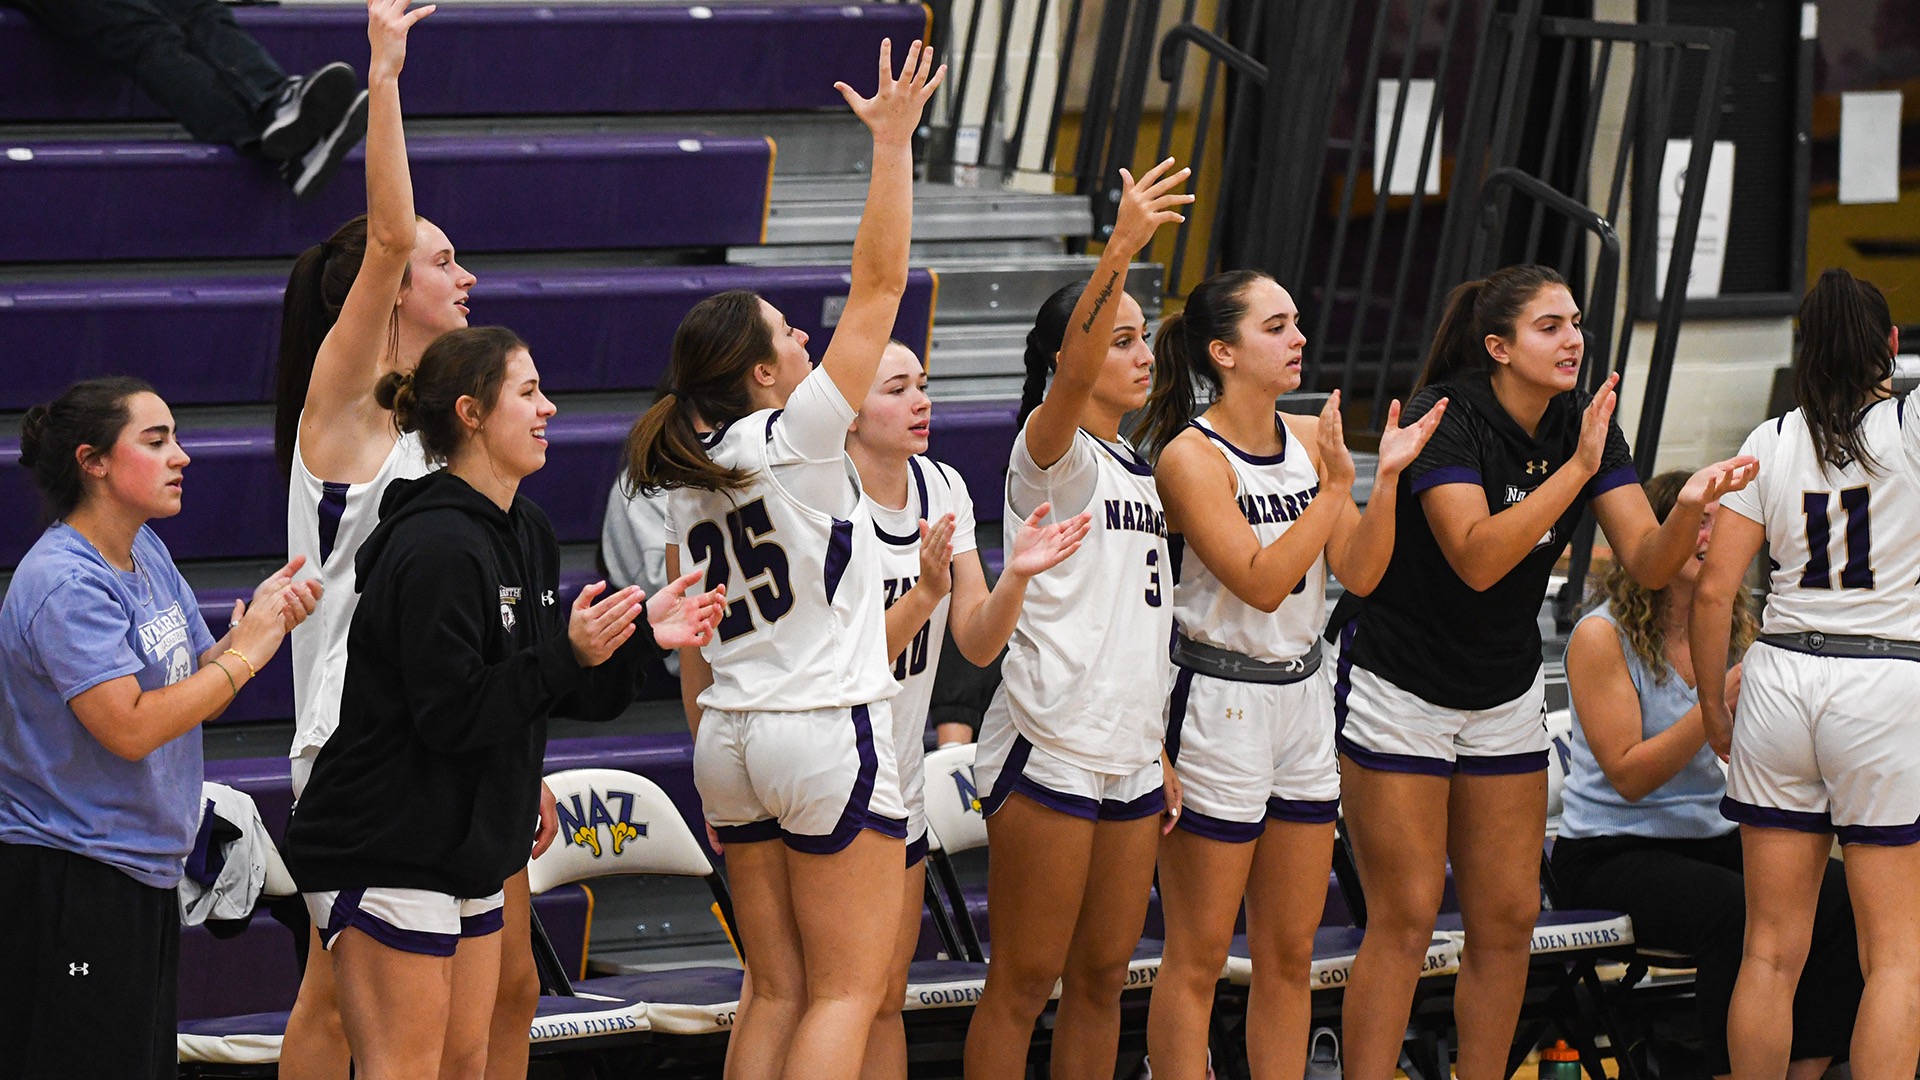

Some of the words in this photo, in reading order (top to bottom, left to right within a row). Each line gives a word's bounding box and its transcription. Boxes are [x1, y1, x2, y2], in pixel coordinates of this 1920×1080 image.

[687, 495, 796, 645] 25
[1798, 484, 1876, 591] 11
[1145, 548, 1162, 608] 3
[556, 785, 649, 858] NAZ
[1531, 934, 1568, 951] LDEN
[1571, 928, 1620, 947] FLYERS
[530, 1021, 579, 1040] OLDEN
[586, 1015, 636, 1035] FLYERS
